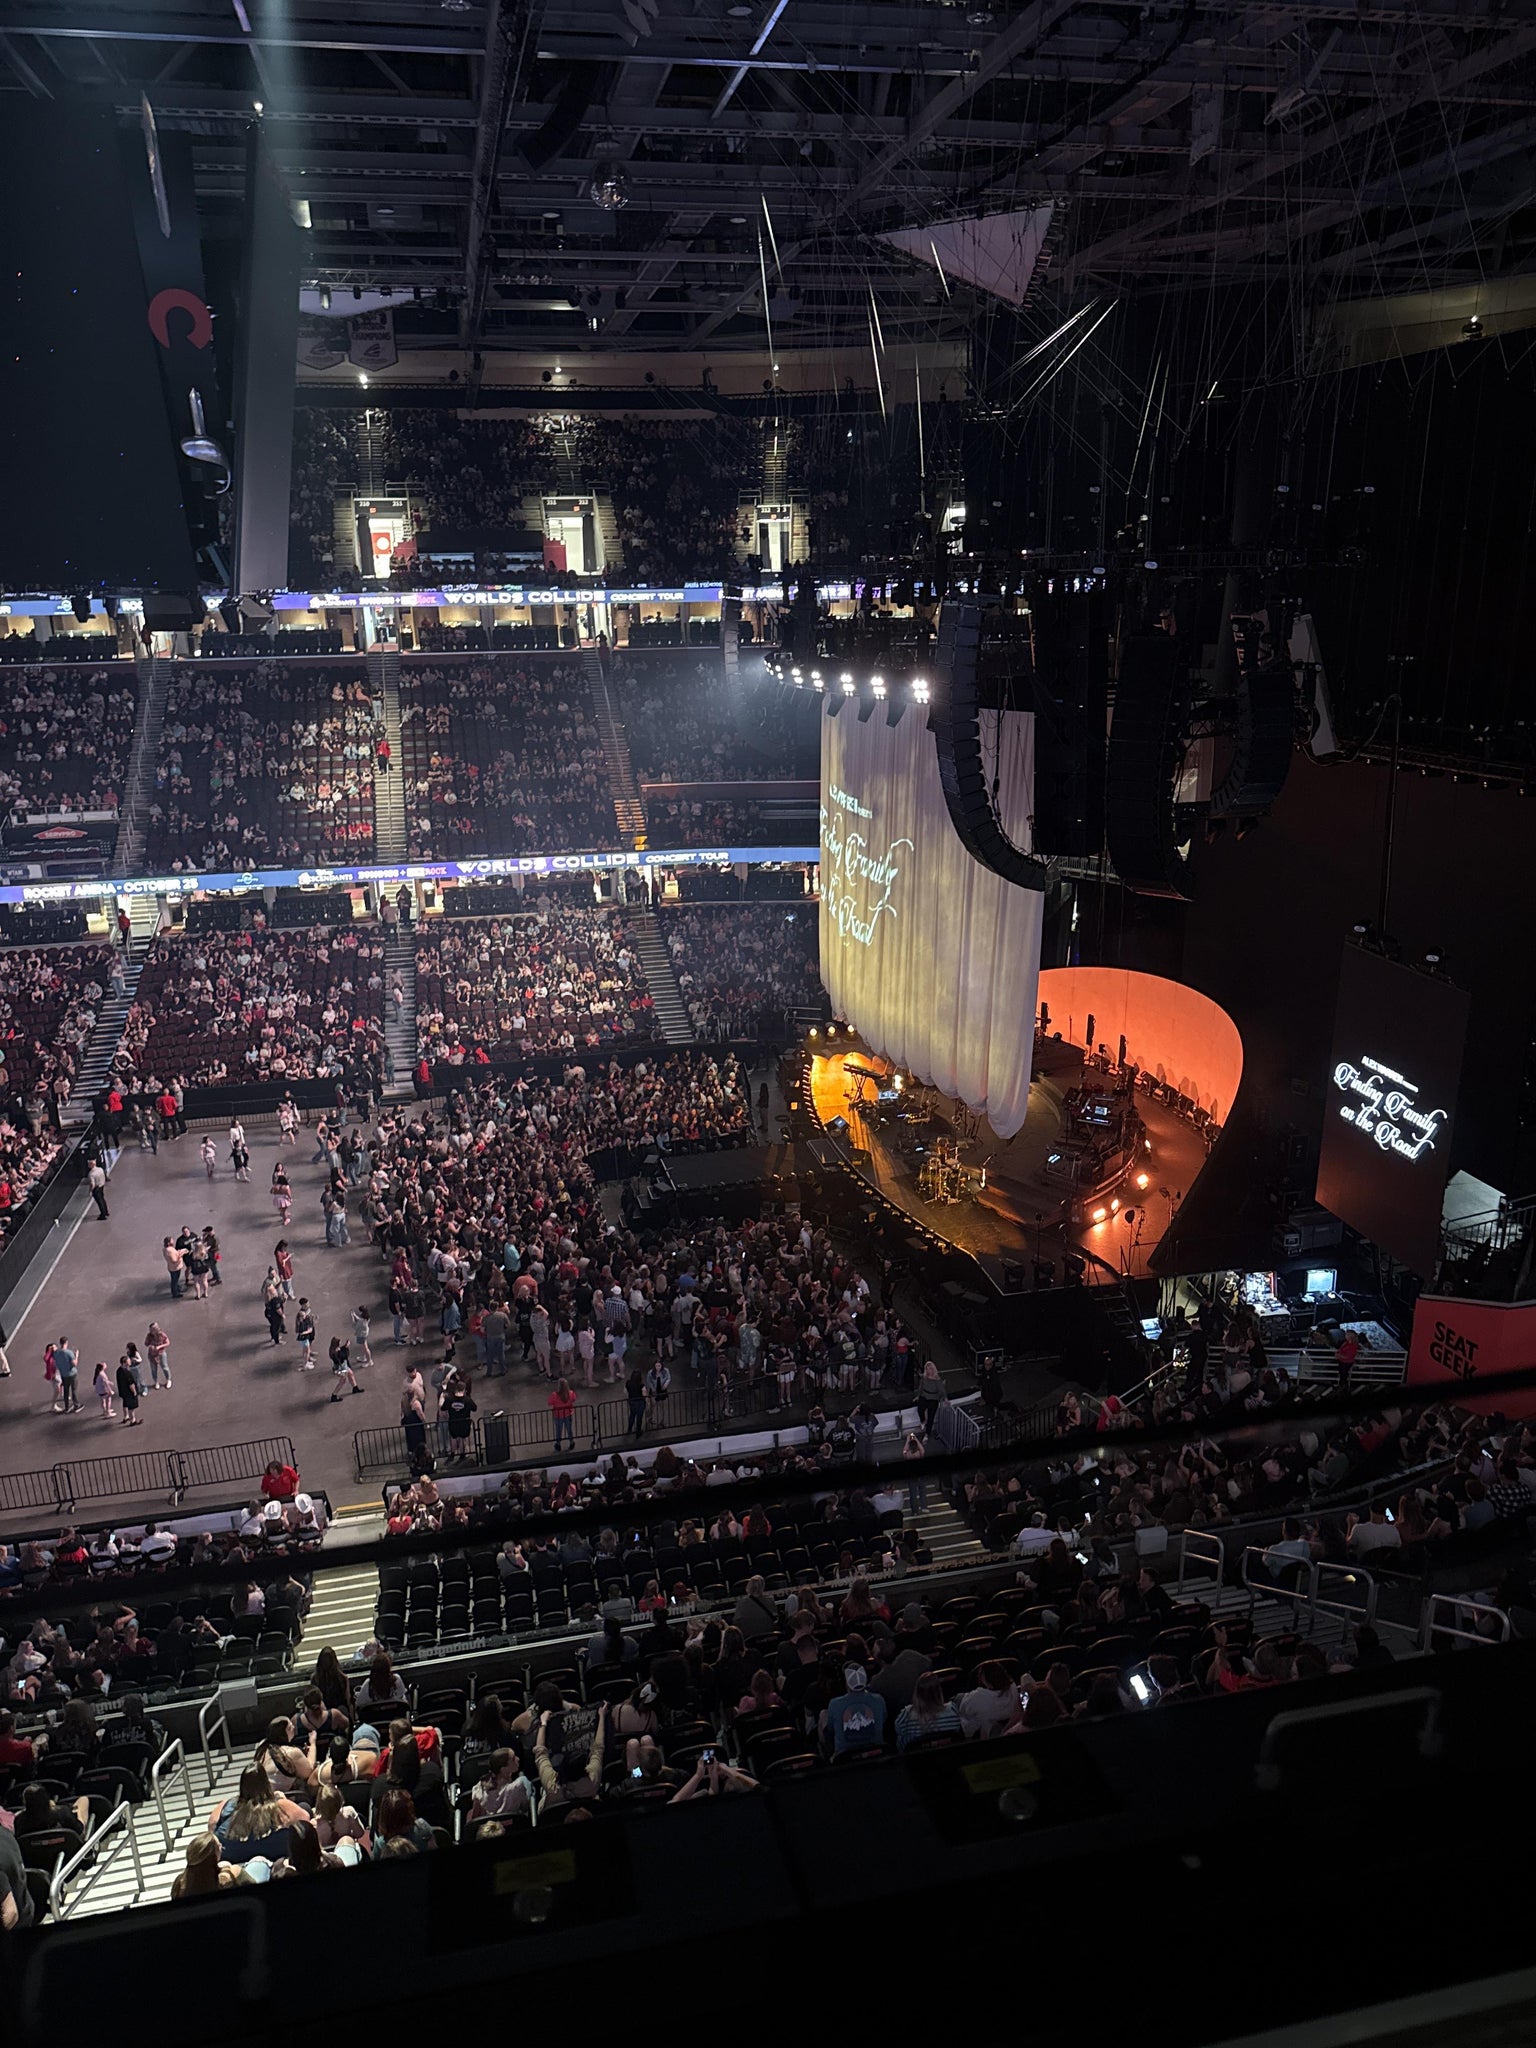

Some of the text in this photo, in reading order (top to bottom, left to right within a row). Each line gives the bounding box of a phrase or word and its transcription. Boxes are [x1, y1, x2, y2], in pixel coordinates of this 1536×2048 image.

[443, 592, 524, 604] WORLDS
[528, 591, 606, 603] COLLIDE
[657, 592, 684, 601] TOUR
[456, 858, 547, 874] WORLDS
[552, 853, 640, 869] COLLIDE
[645, 853, 696, 864] CONCERT
[699, 851, 729, 861] TOUR
[23, 886, 73, 900] ROCKET
[75, 883, 117, 896] ARENA
[124, 879, 181, 893] OCTOBER
[1333, 1062, 1448, 1142] Finding Family
[1340, 1102, 1435, 1160] on the Road
[1429, 1341, 1479, 1380] GEEK
[1434, 1321, 1479, 1362] SEAT
